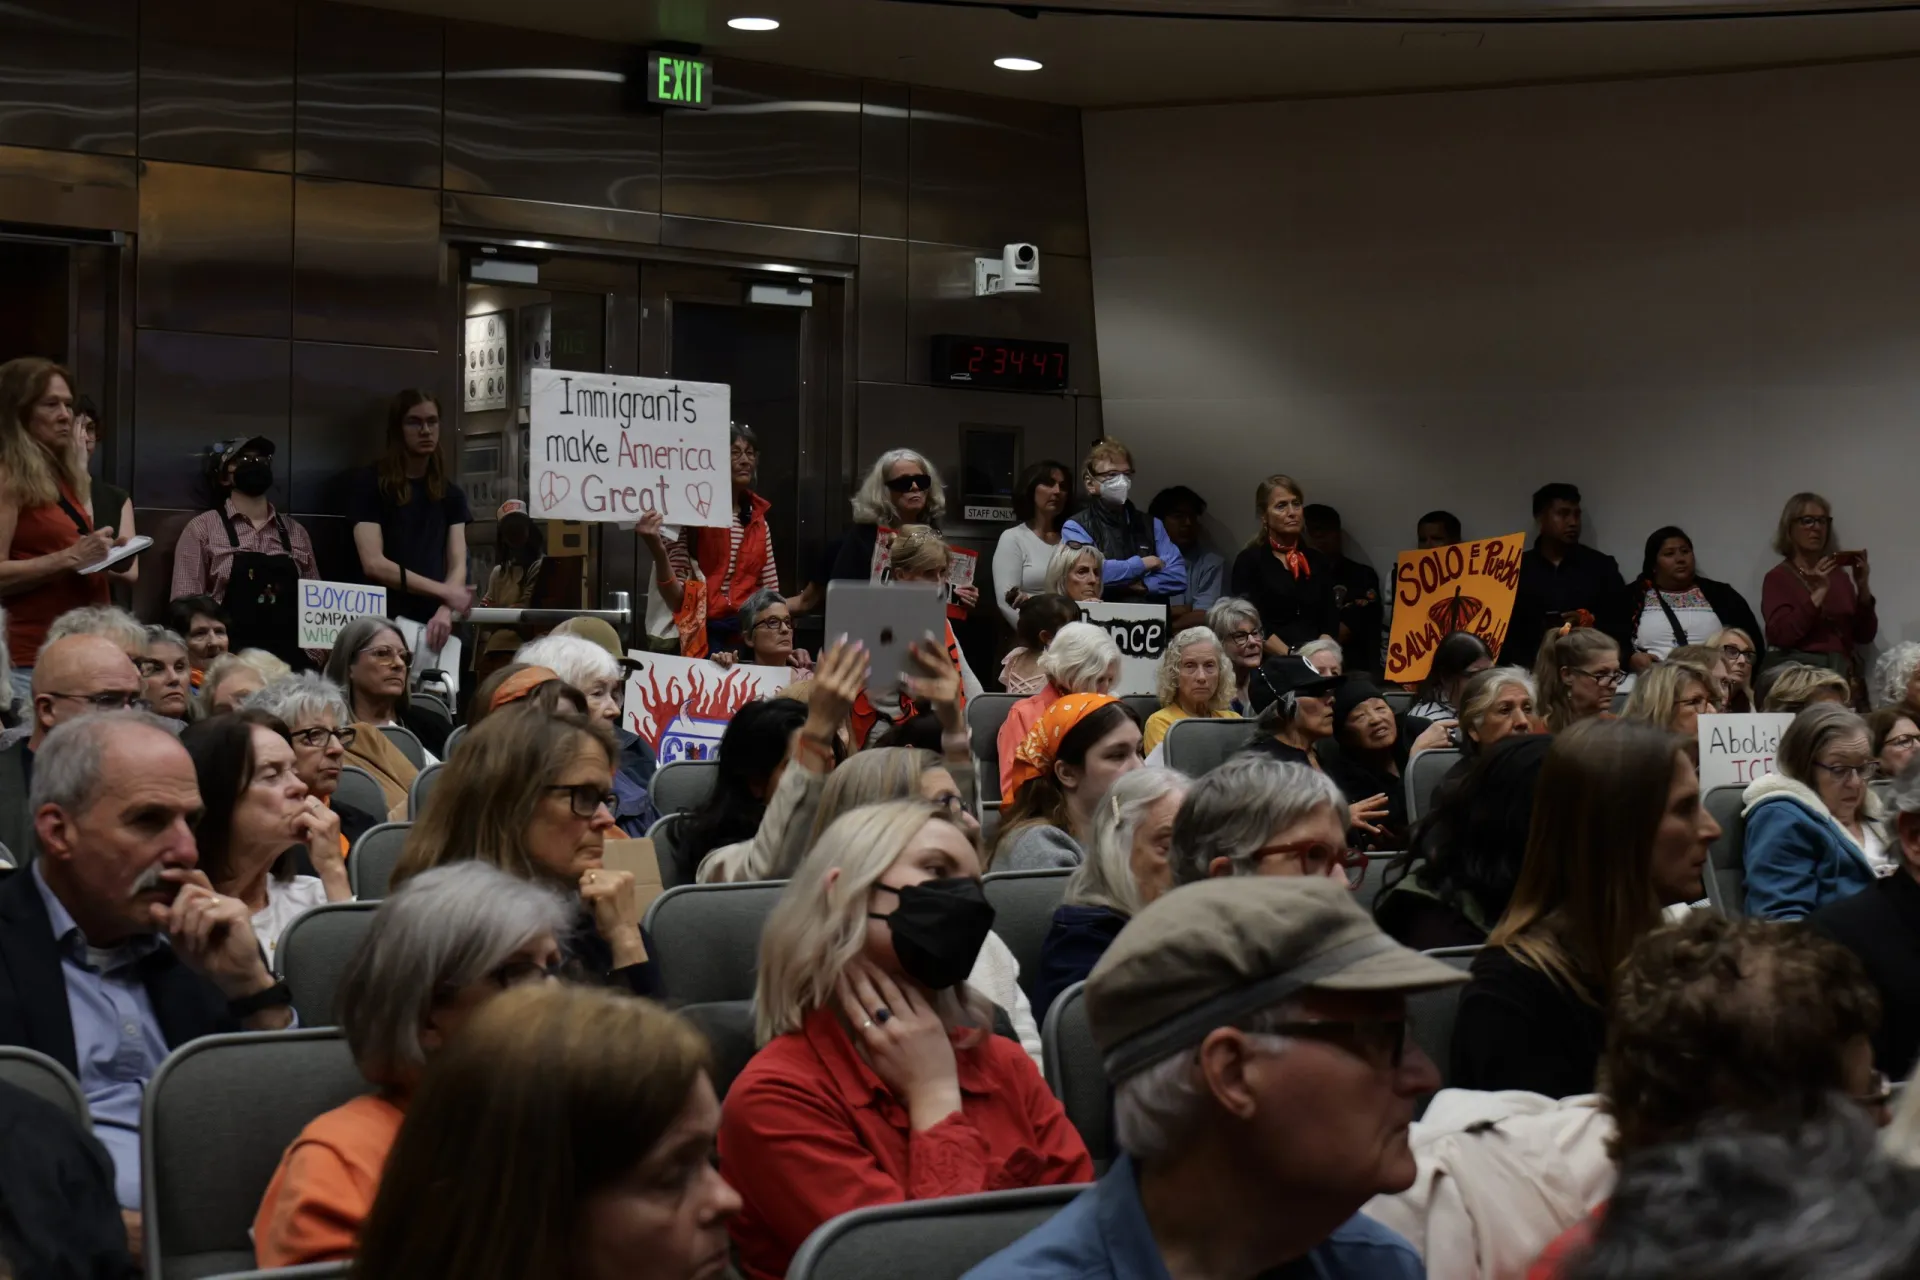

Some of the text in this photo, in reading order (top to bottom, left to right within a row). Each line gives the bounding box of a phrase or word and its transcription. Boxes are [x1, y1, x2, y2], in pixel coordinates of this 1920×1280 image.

[659, 56, 704, 103] EXIT
[560, 377, 697, 429] Immigrants
[546, 429, 716, 471] make America
[581, 474, 670, 515] Great
[968, 508, 1013, 519] STAFF ONLY
[1398, 546, 1464, 607] SOLO
[304, 584, 384, 614] BOYCOTT
